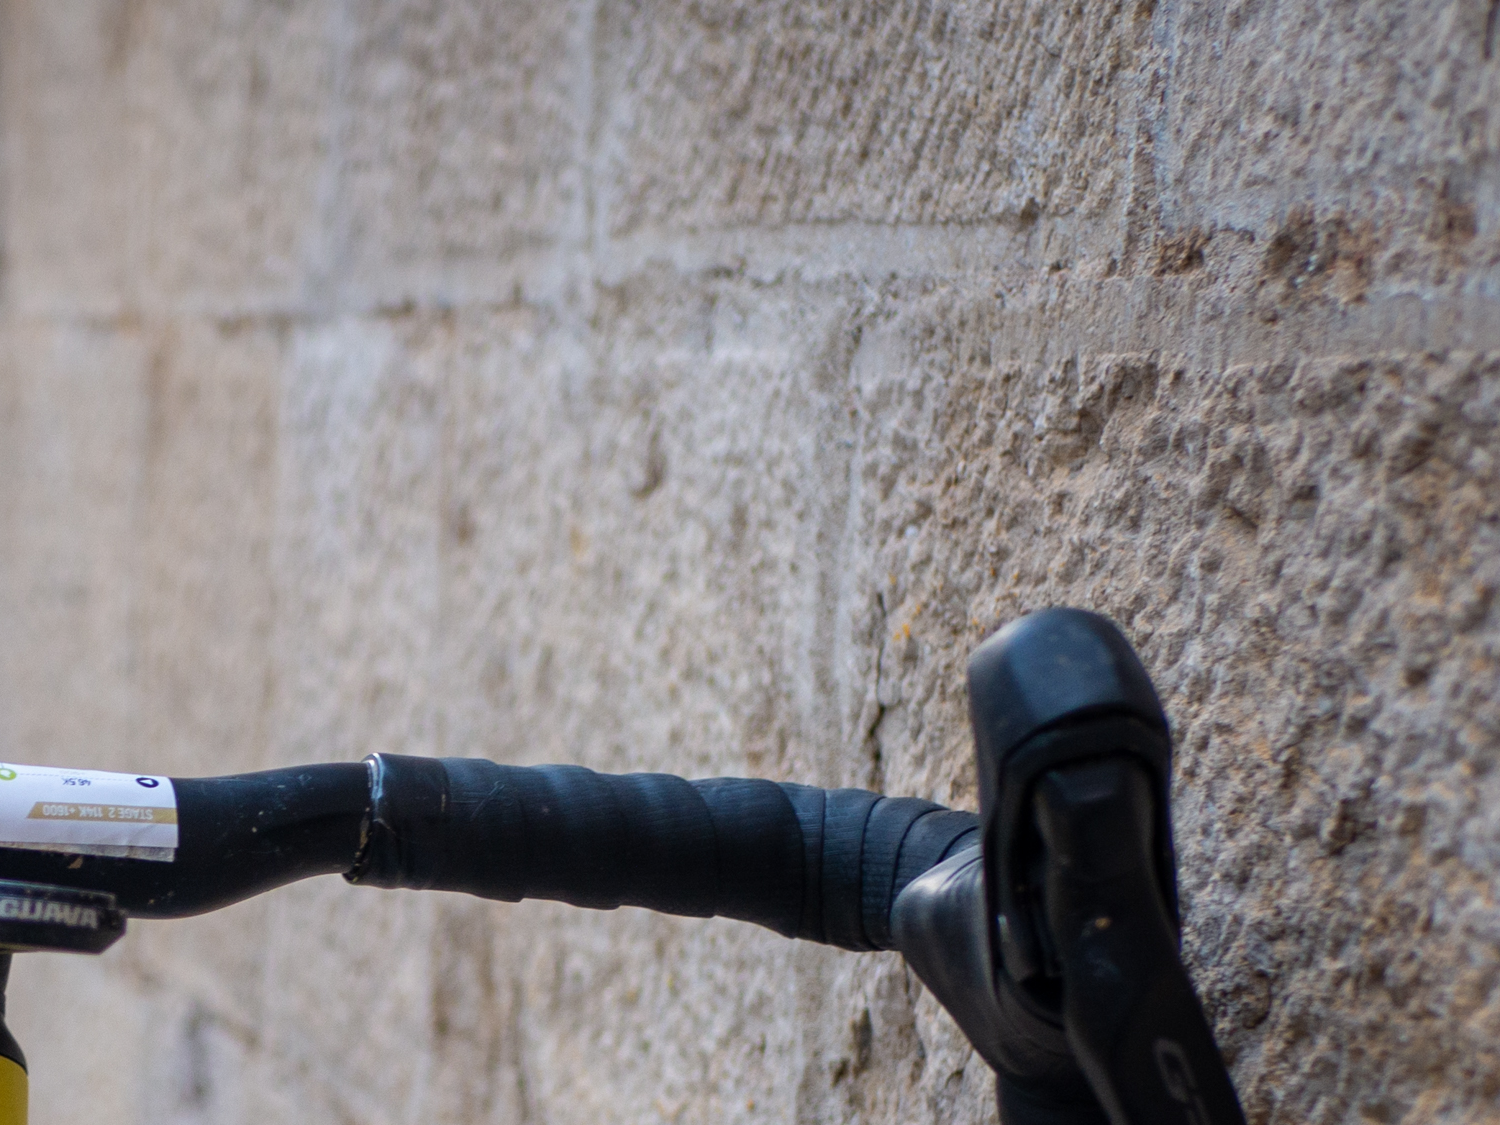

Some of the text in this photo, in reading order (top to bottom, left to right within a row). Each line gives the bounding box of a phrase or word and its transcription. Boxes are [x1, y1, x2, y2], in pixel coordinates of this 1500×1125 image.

[42, 804, 154, 820] STAGE 2 114K +1600
